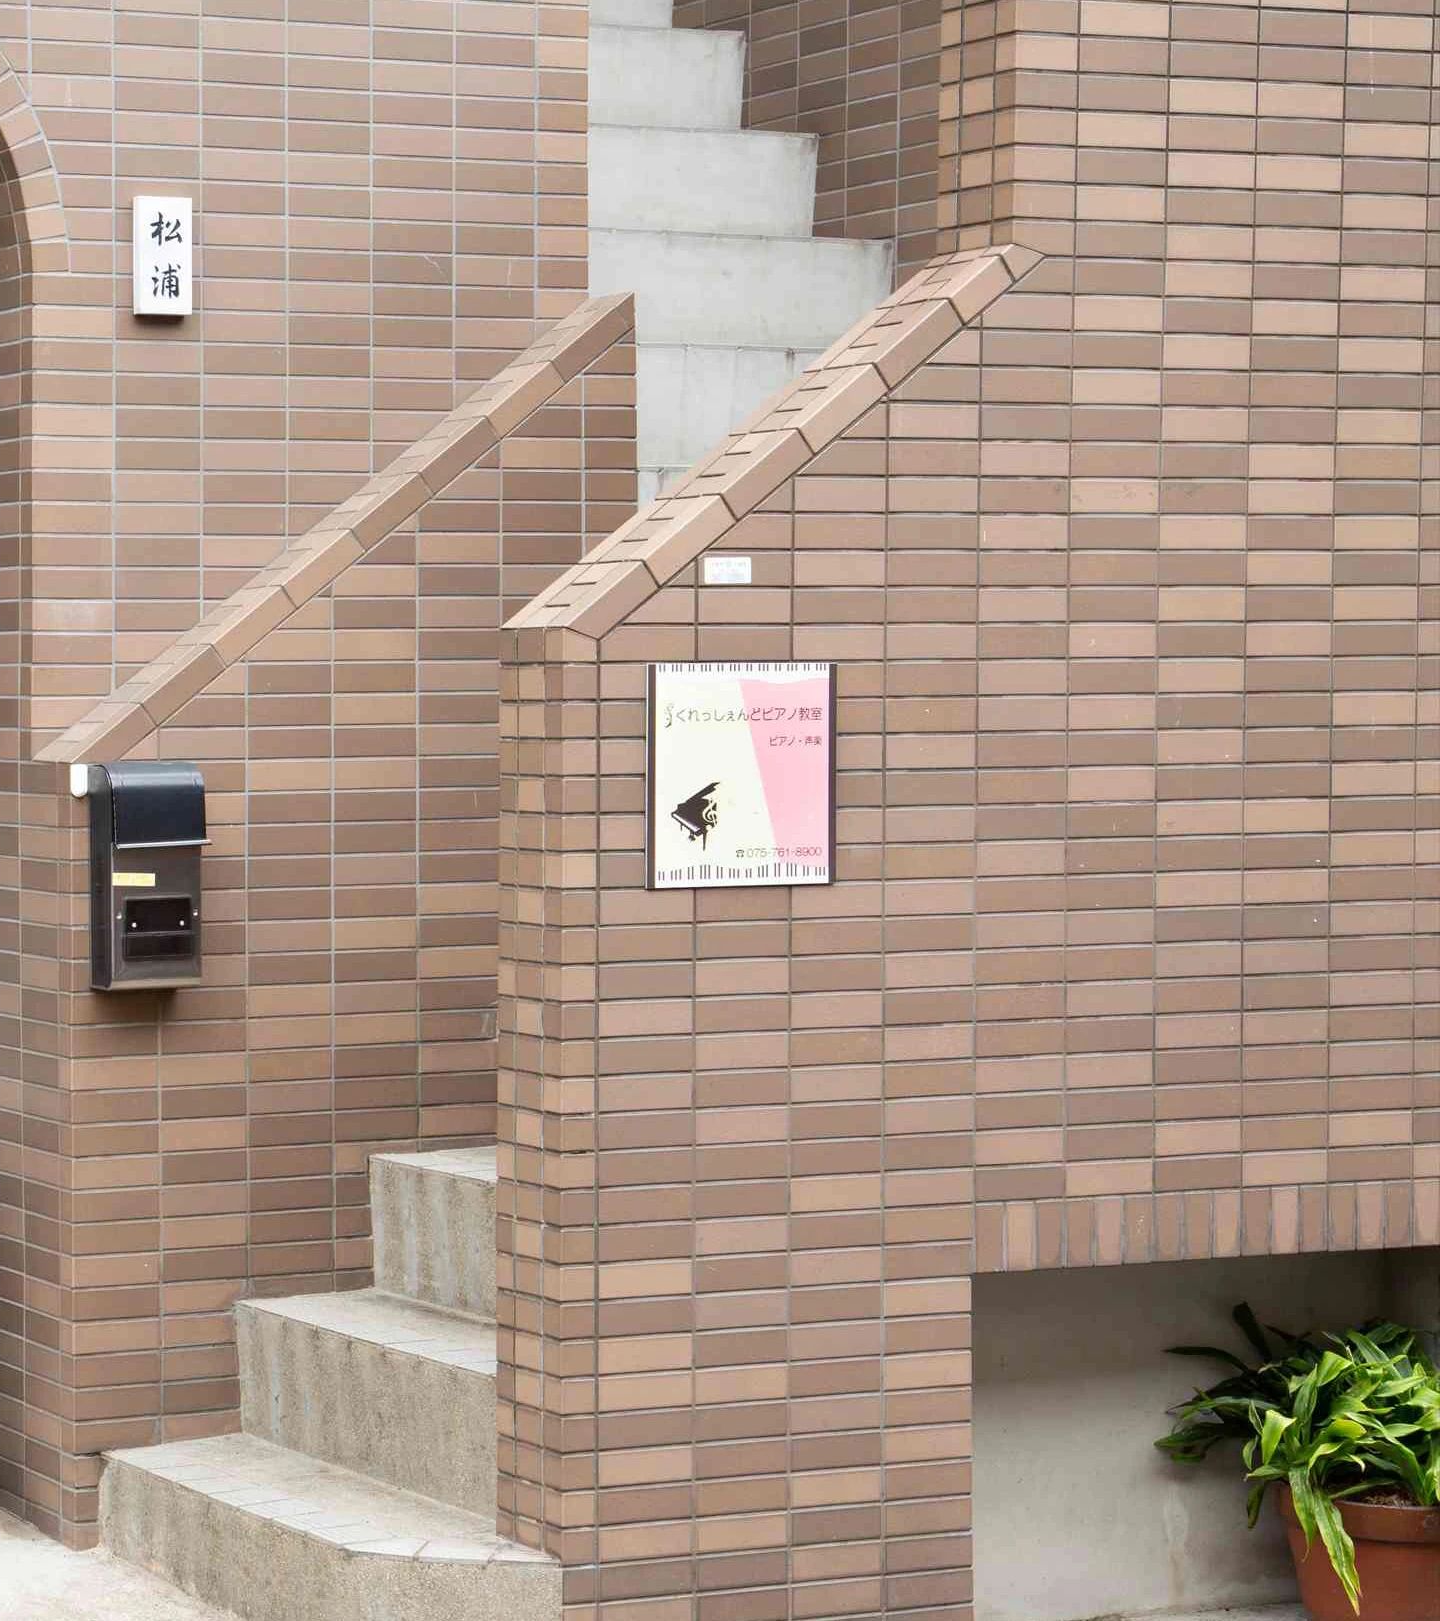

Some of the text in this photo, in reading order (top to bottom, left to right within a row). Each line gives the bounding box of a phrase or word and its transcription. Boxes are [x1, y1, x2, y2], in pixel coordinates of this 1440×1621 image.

[150, 211, 183, 299] 松浦
[676, 707, 823, 722] くれっしぇんどピアノ教室
